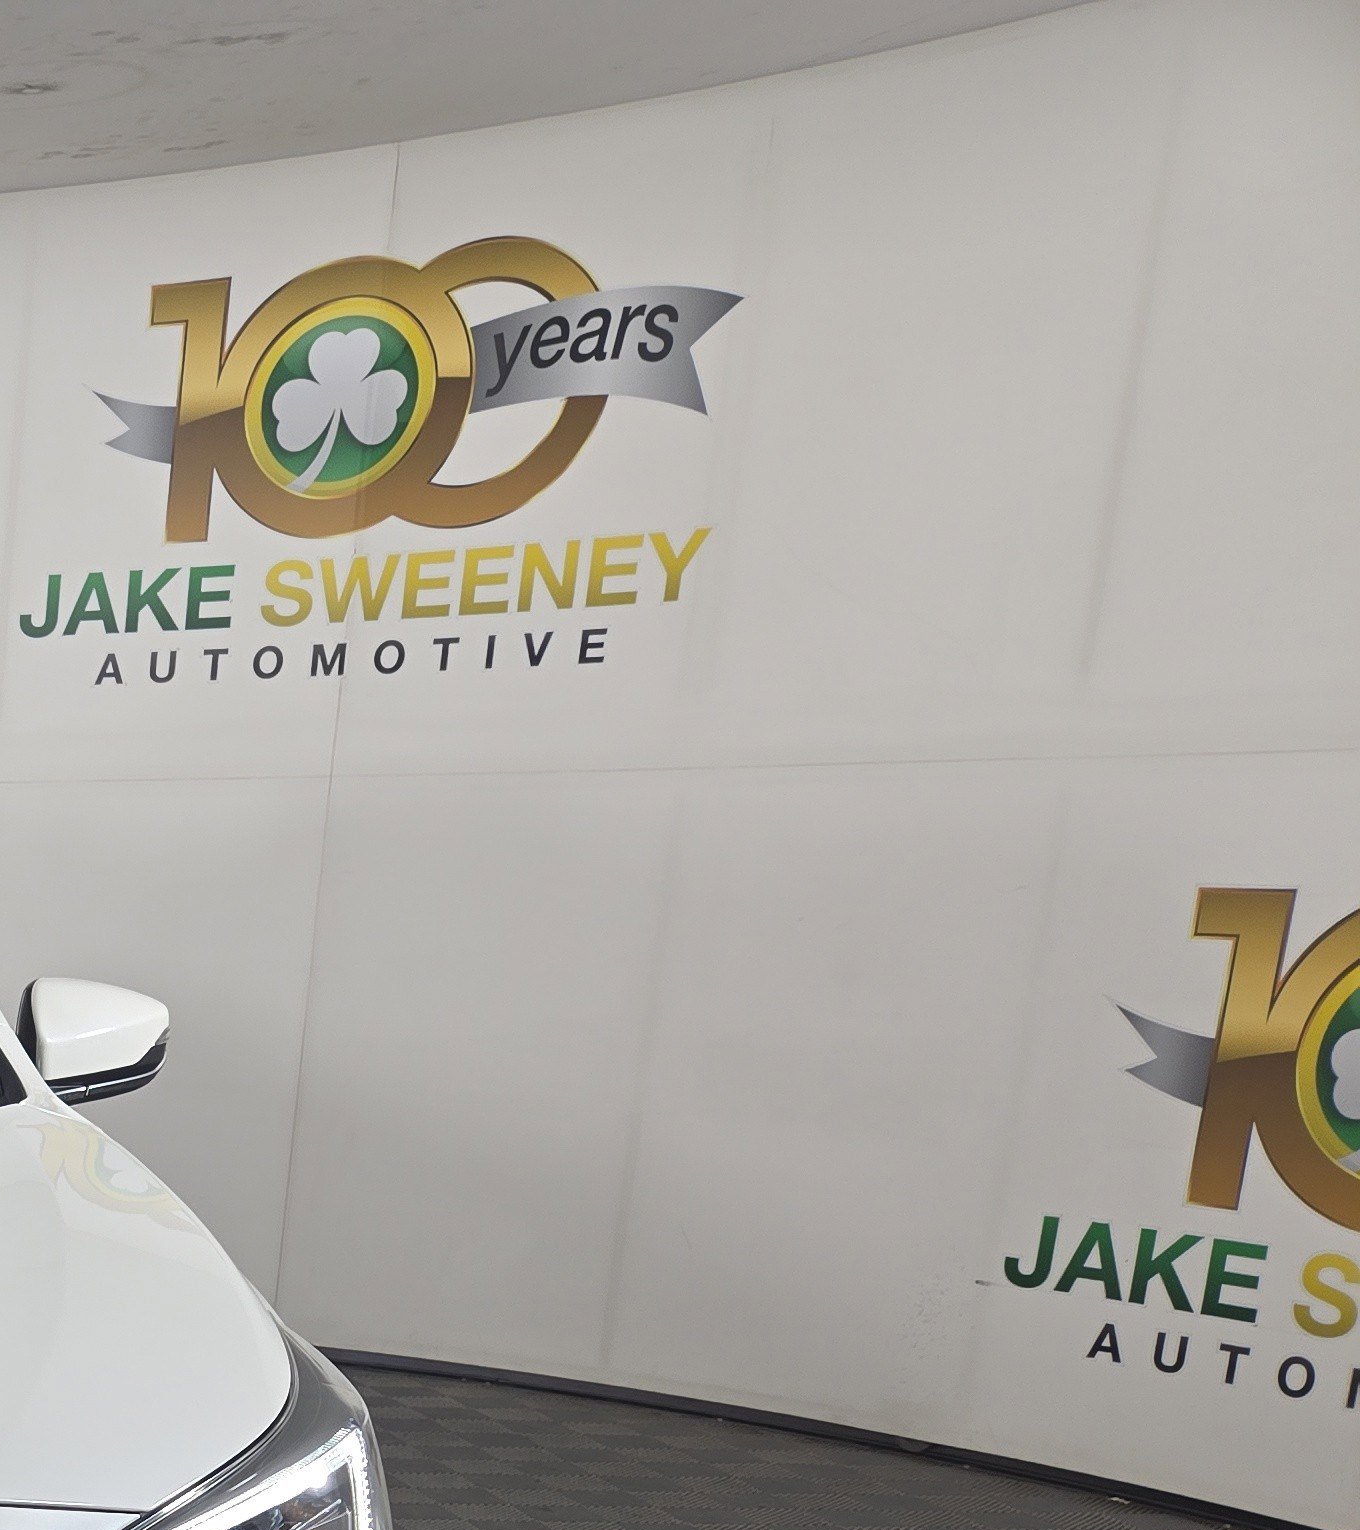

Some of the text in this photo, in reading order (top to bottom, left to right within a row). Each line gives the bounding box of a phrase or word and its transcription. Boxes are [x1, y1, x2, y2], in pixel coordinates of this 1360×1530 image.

[150, 235, 679, 544] 100 years
[19, 527, 712, 638] JAKE SWEENEY
[94, 628, 608, 685] AUTOMOTIVE
[1003, 1215, 1269, 1324] JAKE
[1085, 1323, 1360, 1410] AUTO
